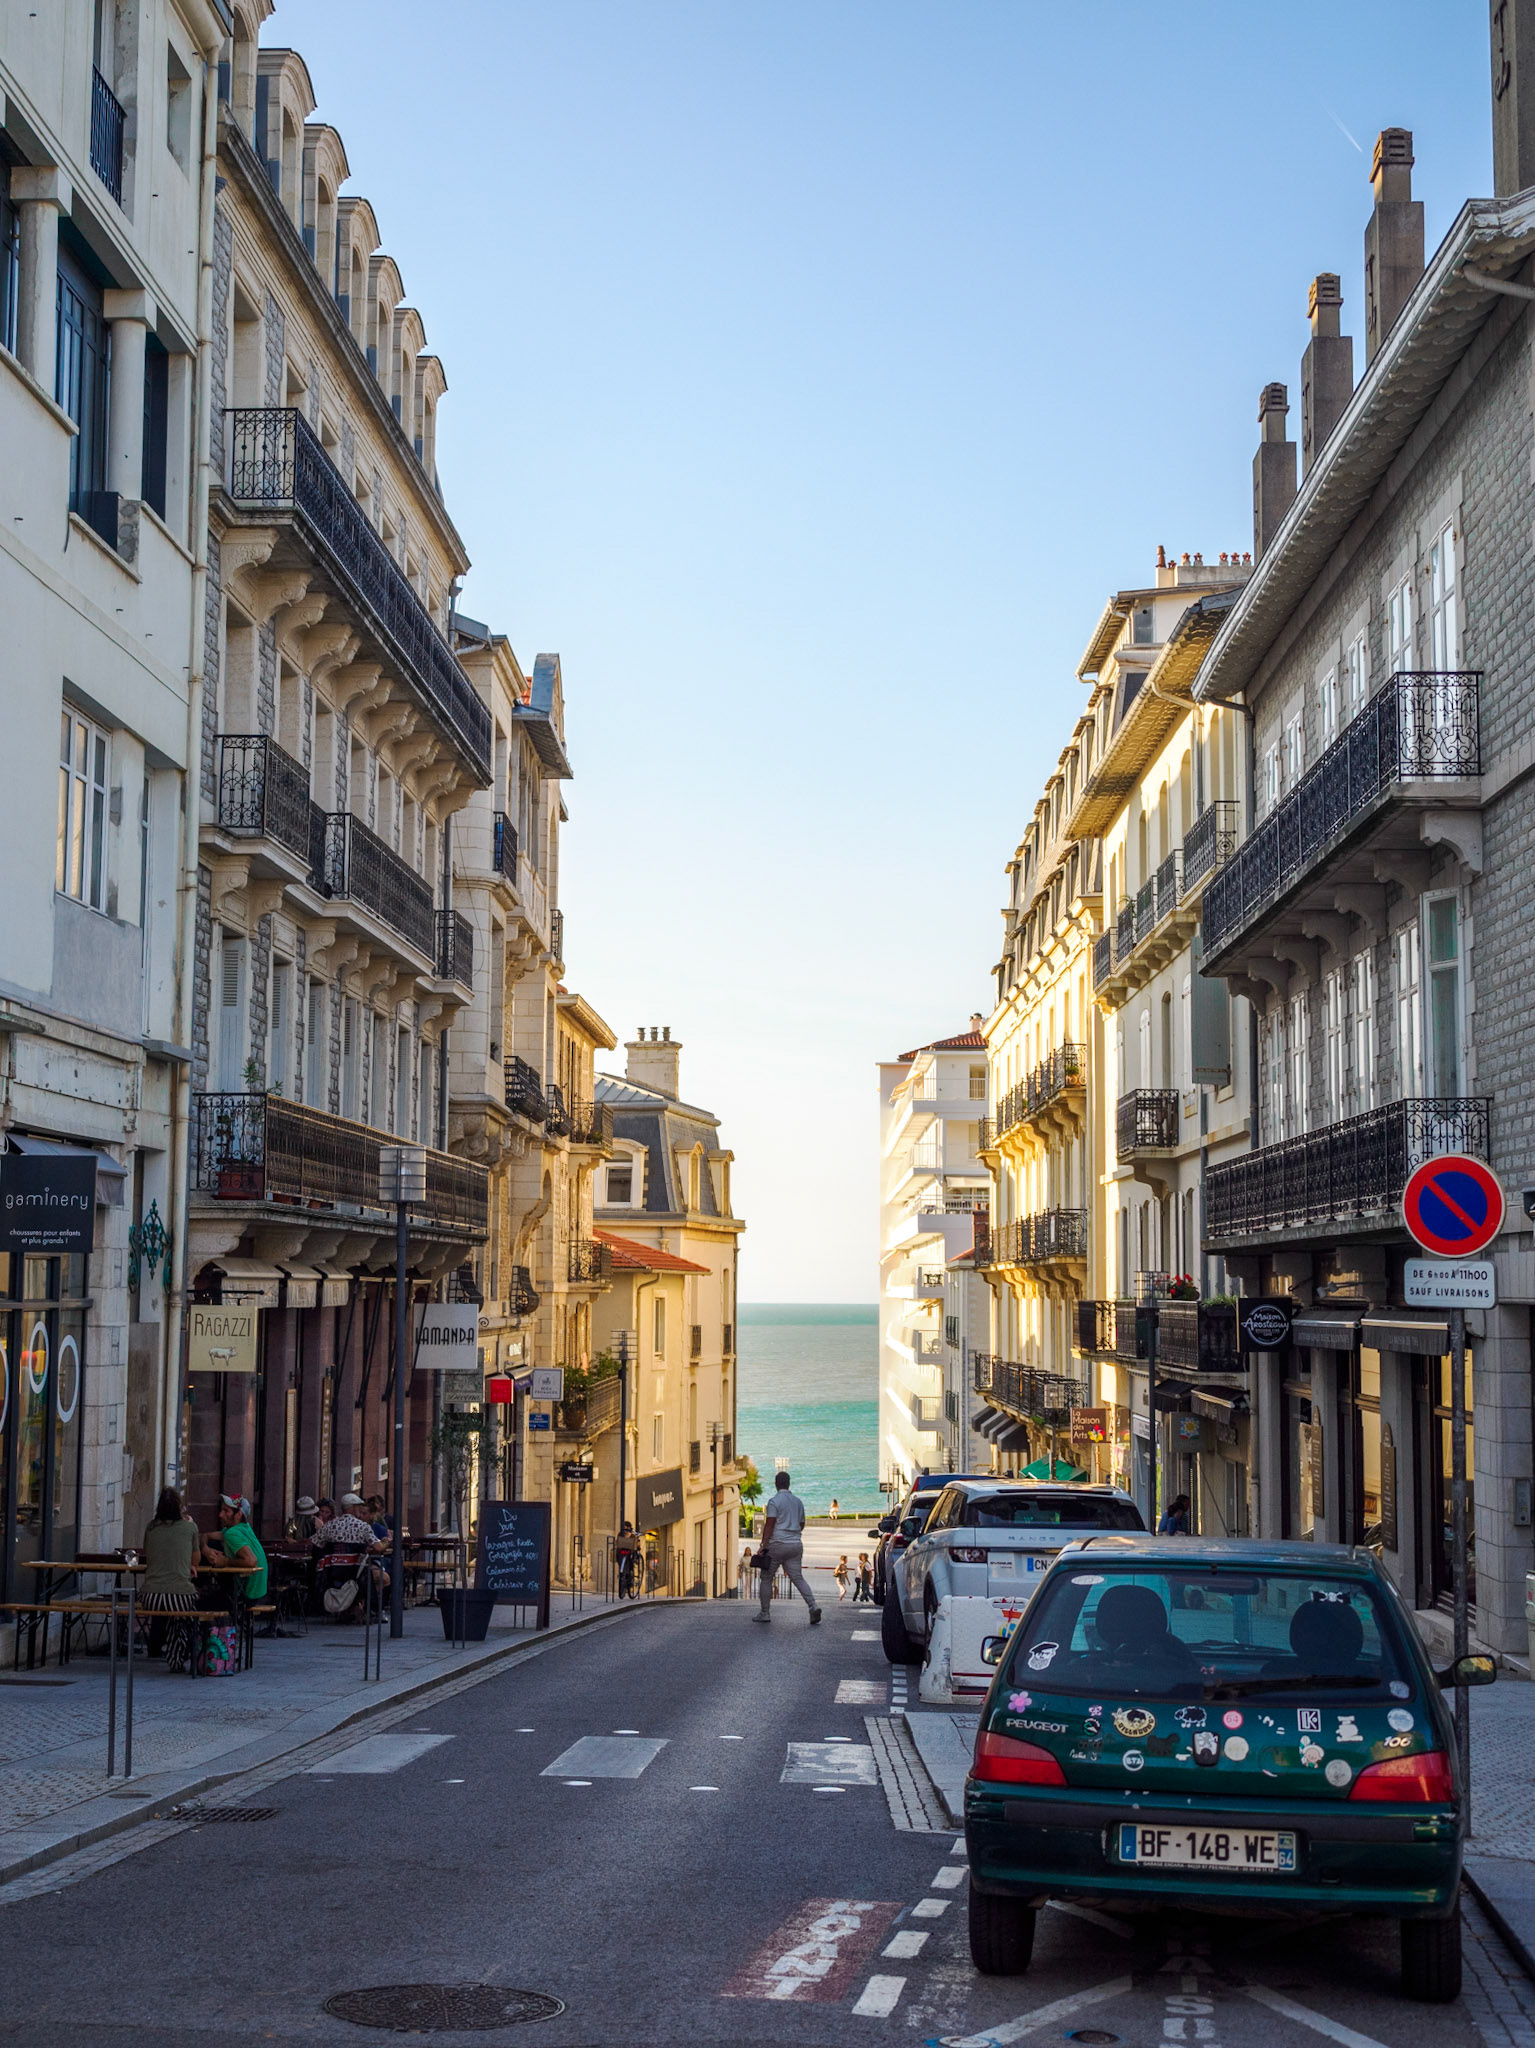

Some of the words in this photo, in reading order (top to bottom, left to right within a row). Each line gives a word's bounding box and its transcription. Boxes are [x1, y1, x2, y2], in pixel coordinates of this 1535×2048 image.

[5, 1187, 89, 1210] gaminery
[9, 1228, 42, 1236] chaussures
[59, 1229, 81, 1237] enfants
[28, 1237, 42, 1246] plus
[42, 1237, 64, 1246] grands
[1413, 1269, 1424, 1279] DE
[1428, 1270, 1449, 1279] 6h00
[1459, 1269, 1488, 1281] 11h00
[1409, 1287, 1432, 1296] SAUF
[1436, 1287, 1490, 1298] LIVRAISONS
[1253, 1313, 1281, 1321] Maison
[194, 1313, 251, 1337] RAGAZZI
[1072, 1416, 1100, 1424] Maison
[1073, 1431, 1088, 1439] Arts
[1005, 1717, 1069, 1734] PEUGEOT
[1383, 1735, 1412, 1748] 106
[1125, 1845, 1131, 1854] F
[1279, 1851, 1293, 1866] 64
